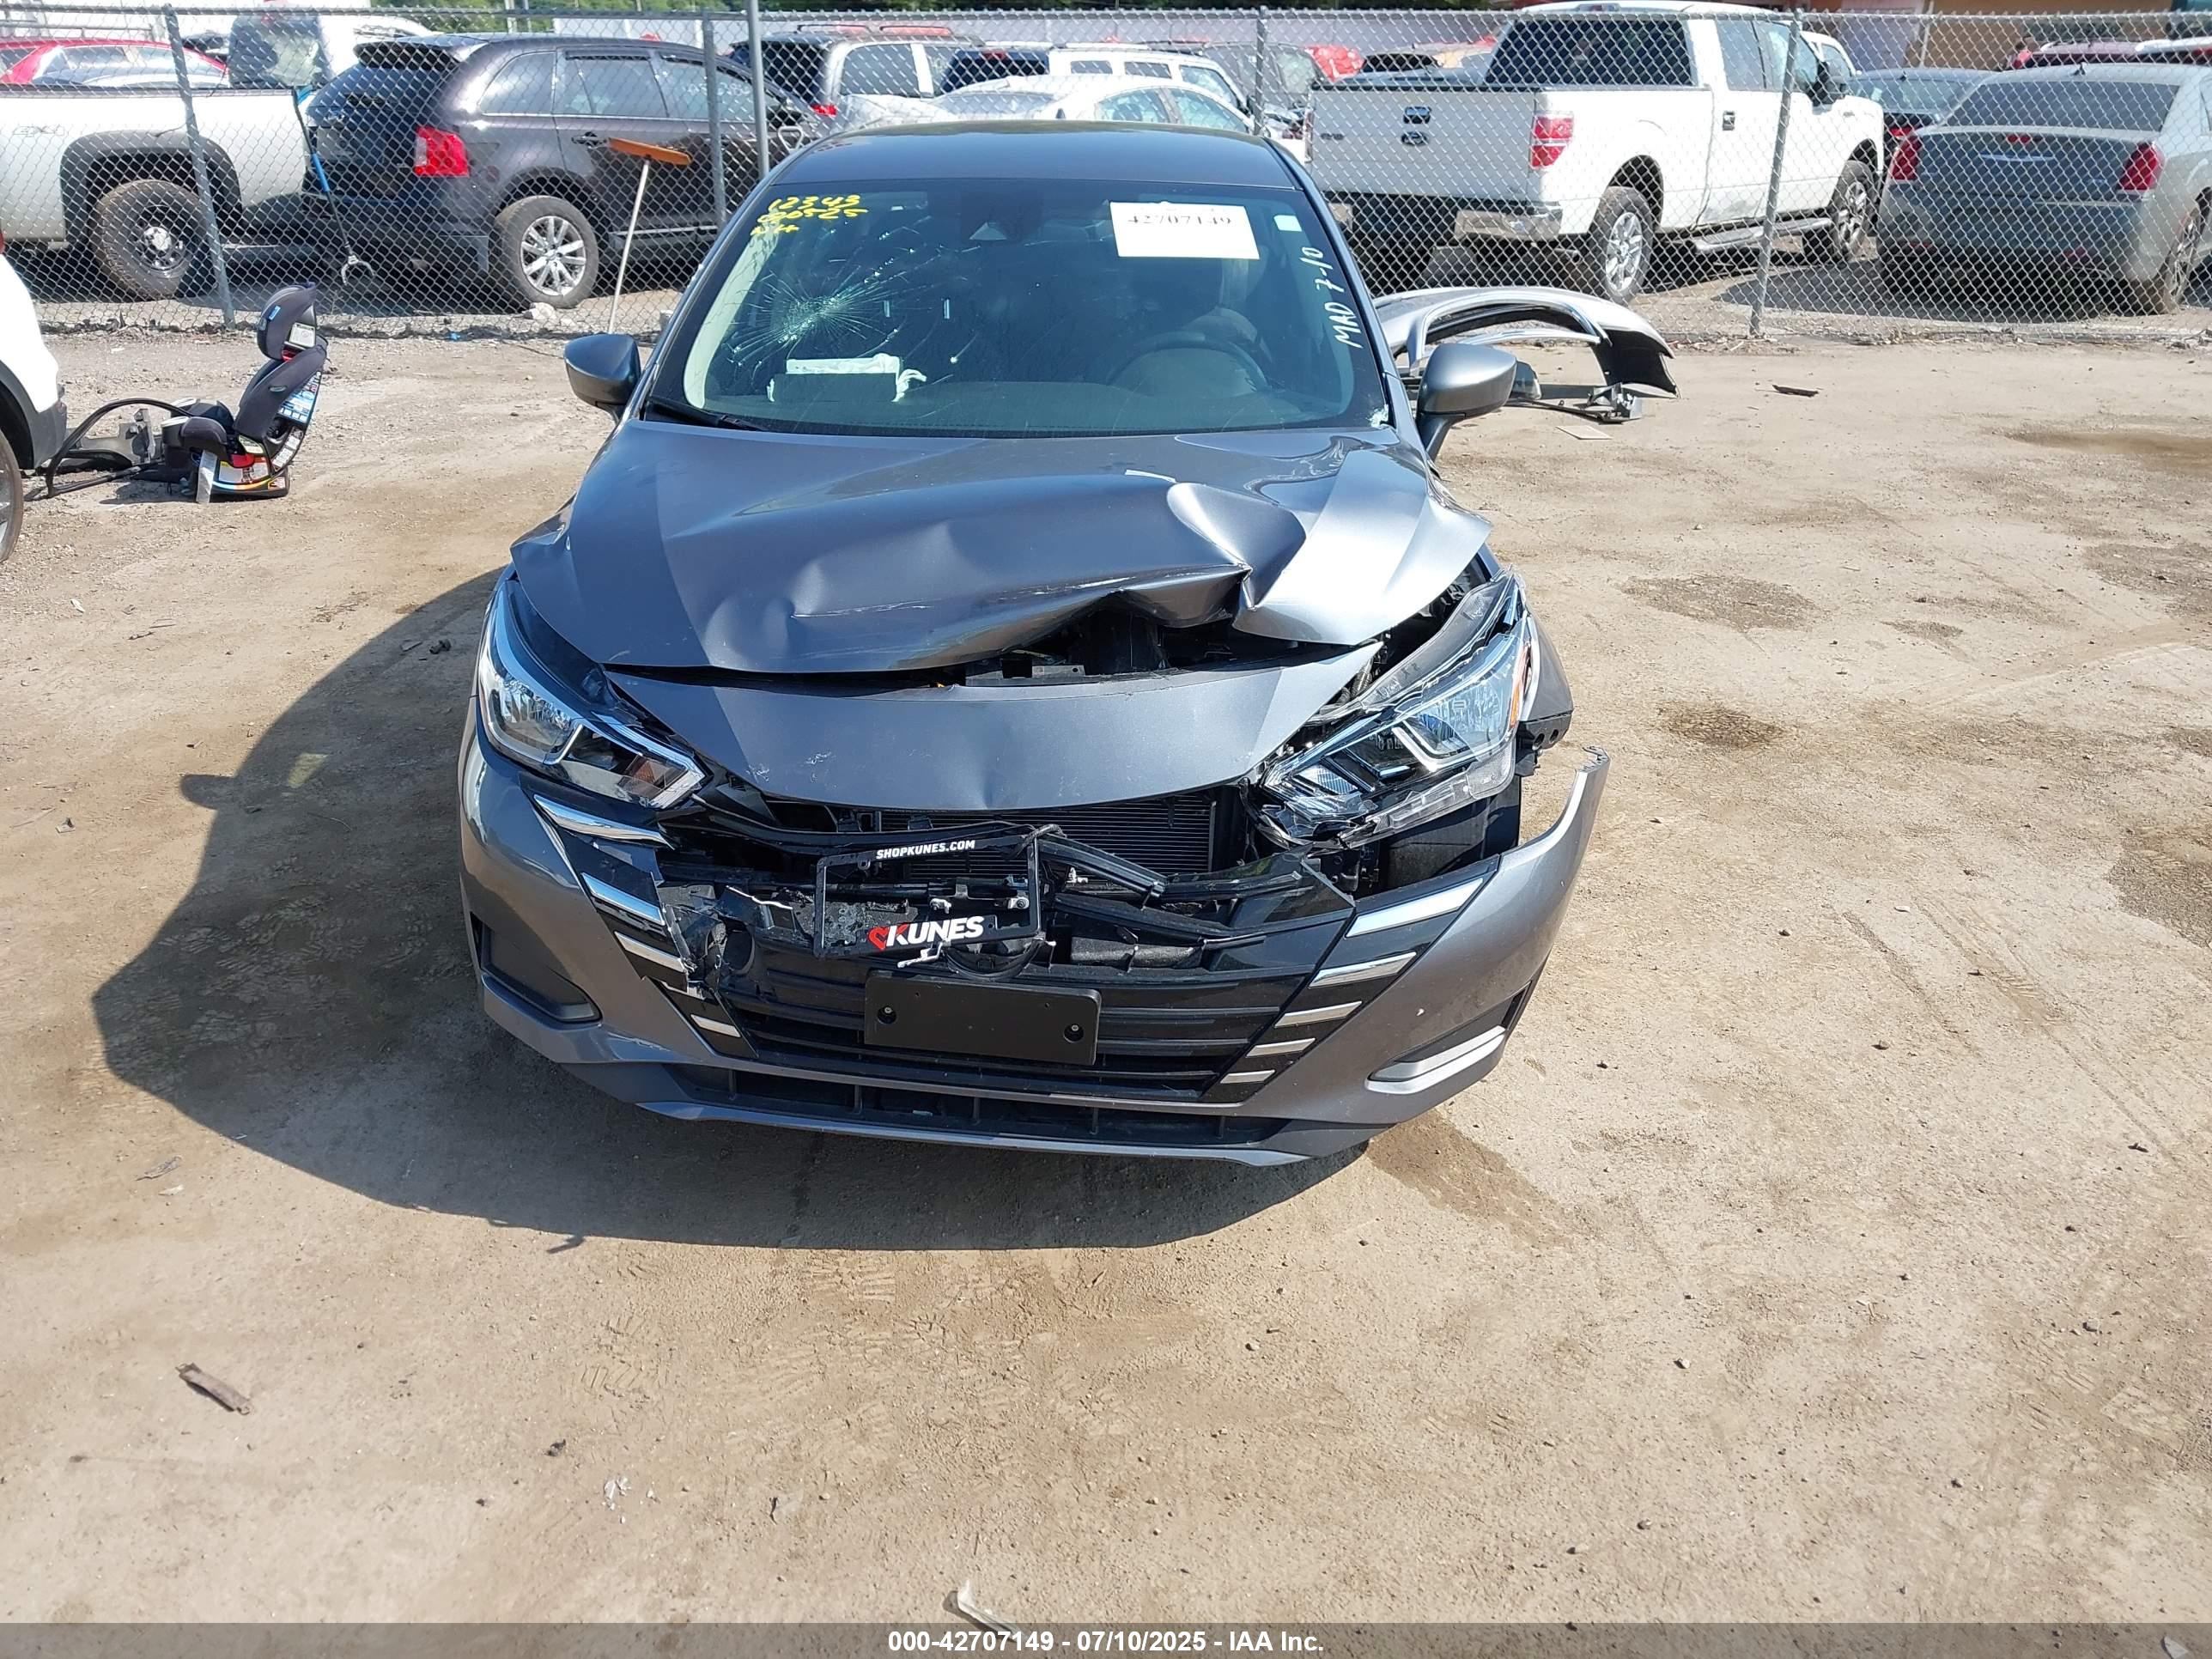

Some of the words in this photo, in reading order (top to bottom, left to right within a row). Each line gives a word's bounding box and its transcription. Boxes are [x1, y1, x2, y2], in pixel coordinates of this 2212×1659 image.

[1299, 246, 1345, 293] 7-10
[1324, 301, 1364, 349] MAD
[876, 840, 975, 860] SHOPKUNES.COM
[885, 915, 985, 947] KUNES
